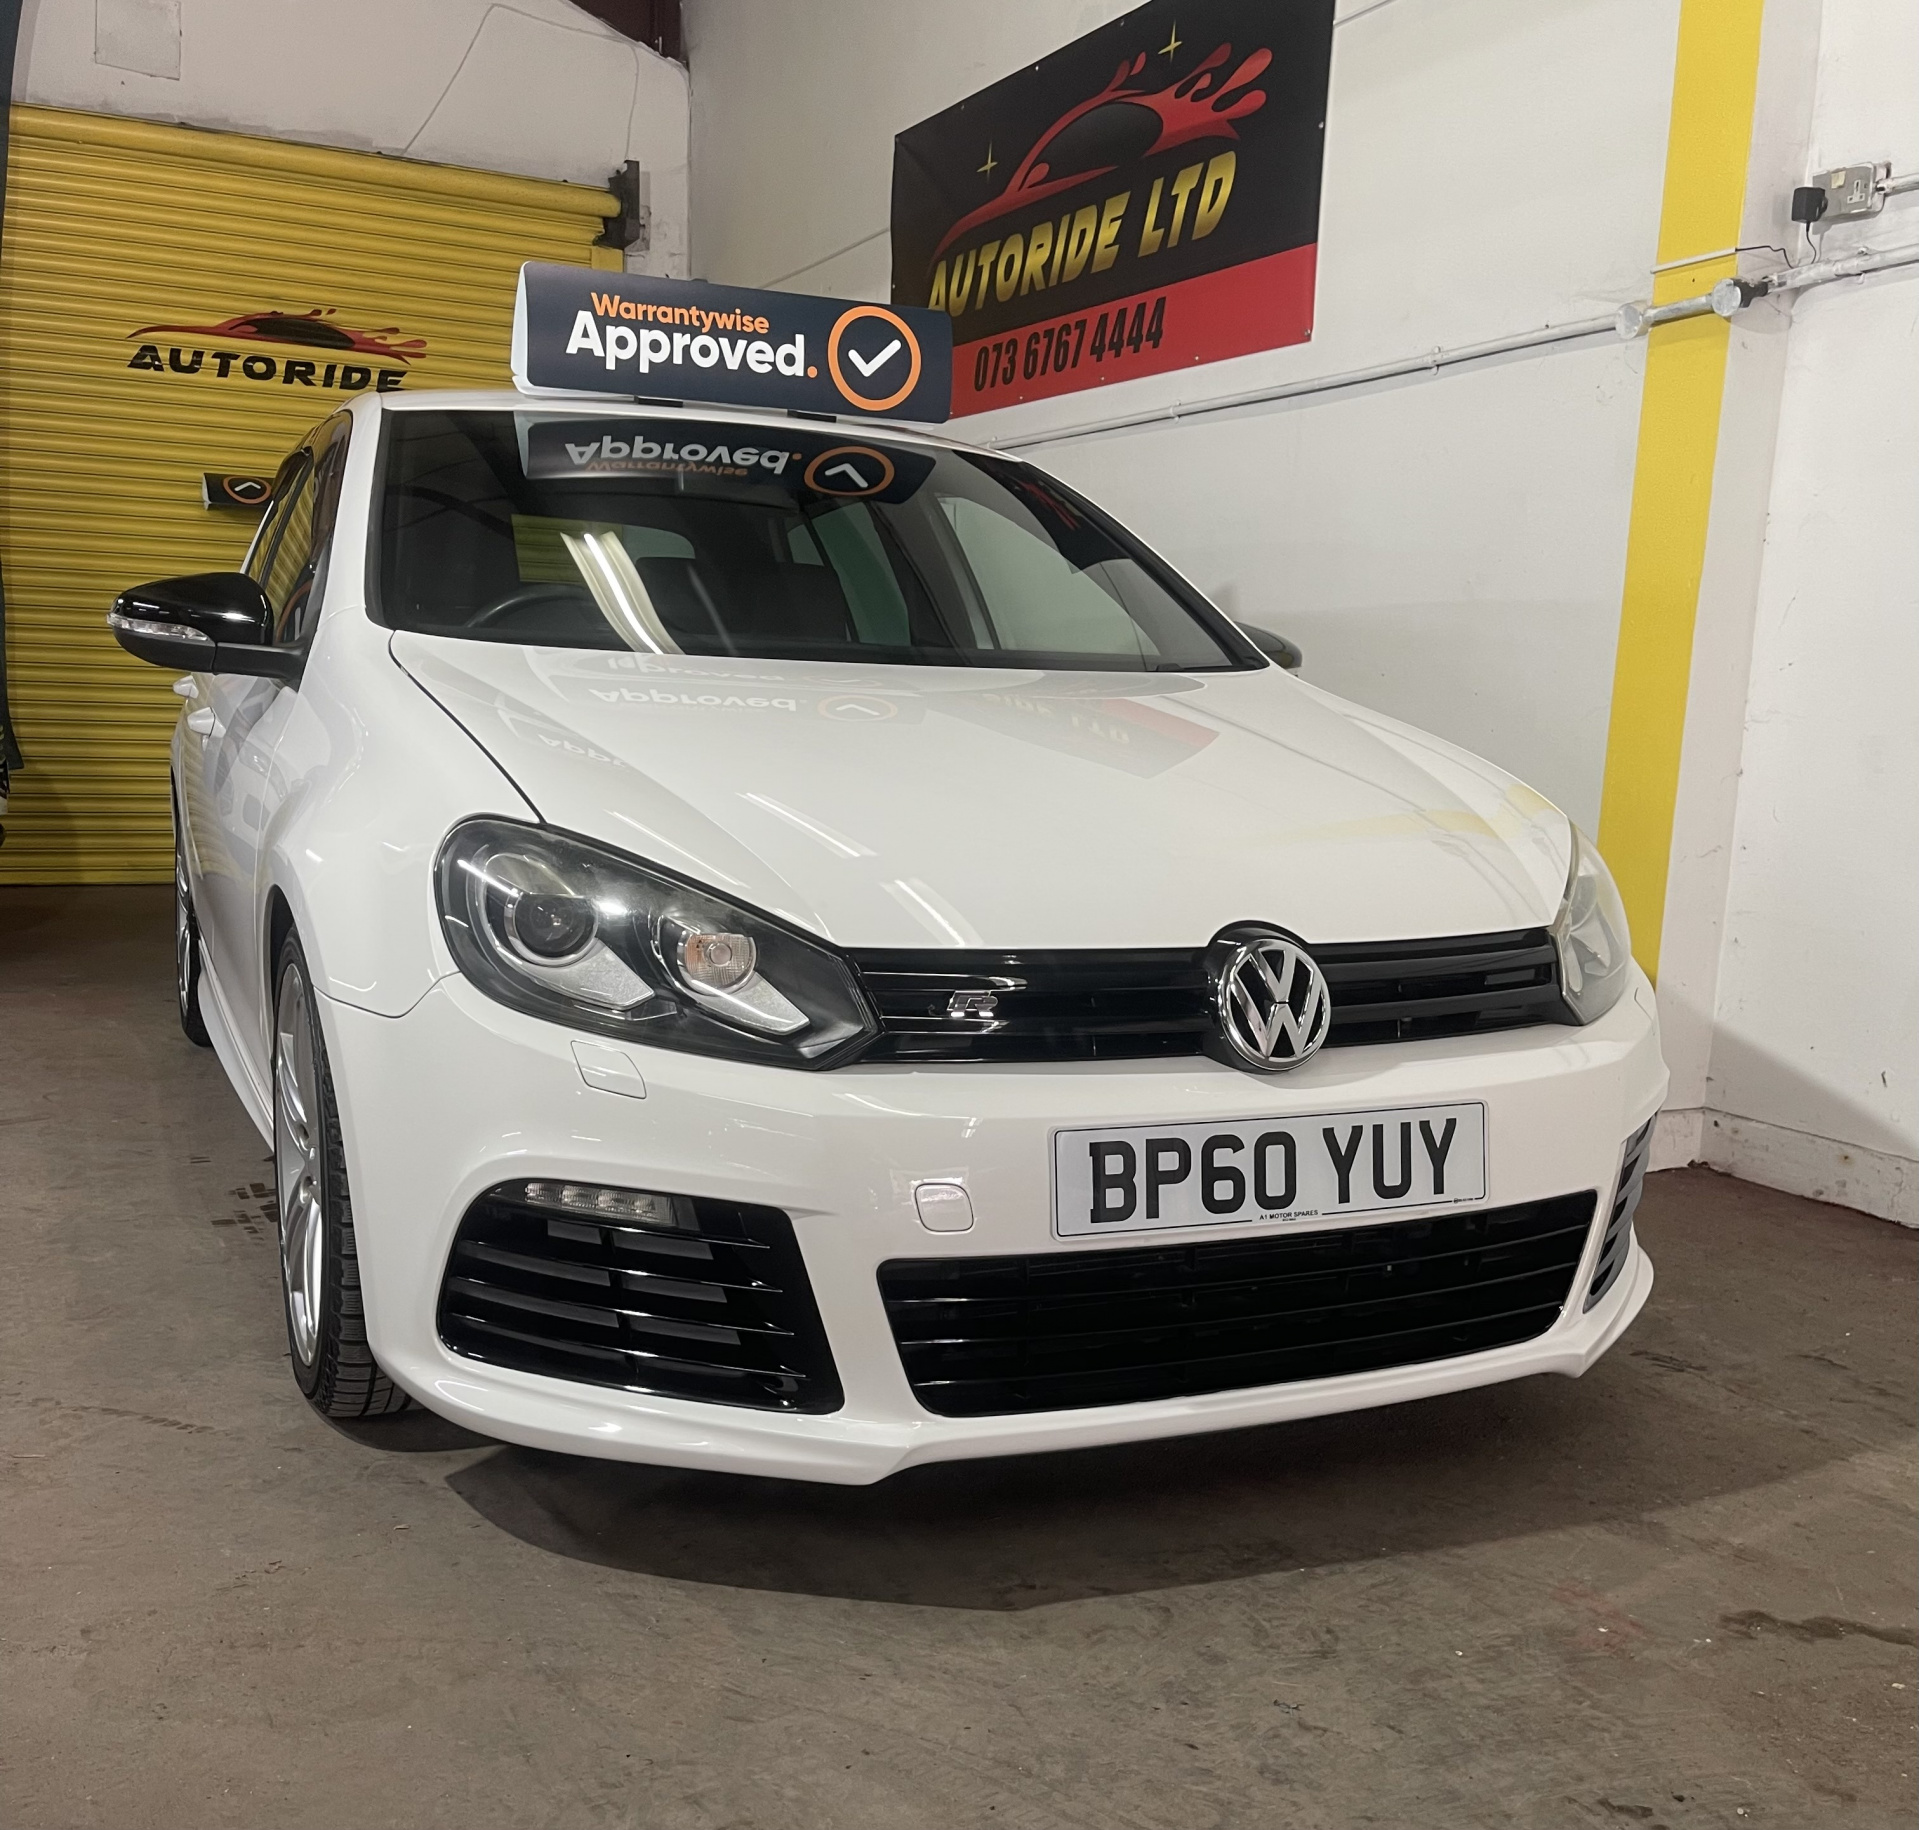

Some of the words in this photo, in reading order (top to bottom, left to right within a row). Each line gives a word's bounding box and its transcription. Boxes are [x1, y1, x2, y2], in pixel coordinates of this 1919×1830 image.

[927, 191, 1131, 317] AUTORIDE
[1138, 151, 1237, 257] LTD
[591, 292, 770, 334] Warrantywise
[127, 344, 409, 392] AUTORIDE
[565, 310, 818, 378] Approved.
[974, 338, 1018, 391] 073
[1023, 319, 1088, 380] 6767
[1090, 296, 1166, 362] 4444
[947, 990, 999, 1017] R
[1089, 1131, 1297, 1224] BP60
[1322, 1118, 1457, 1204] YUY
[1269, 1212, 1293, 1220] MOTOR
[1294, 1209, 1319, 1218] SPARES
